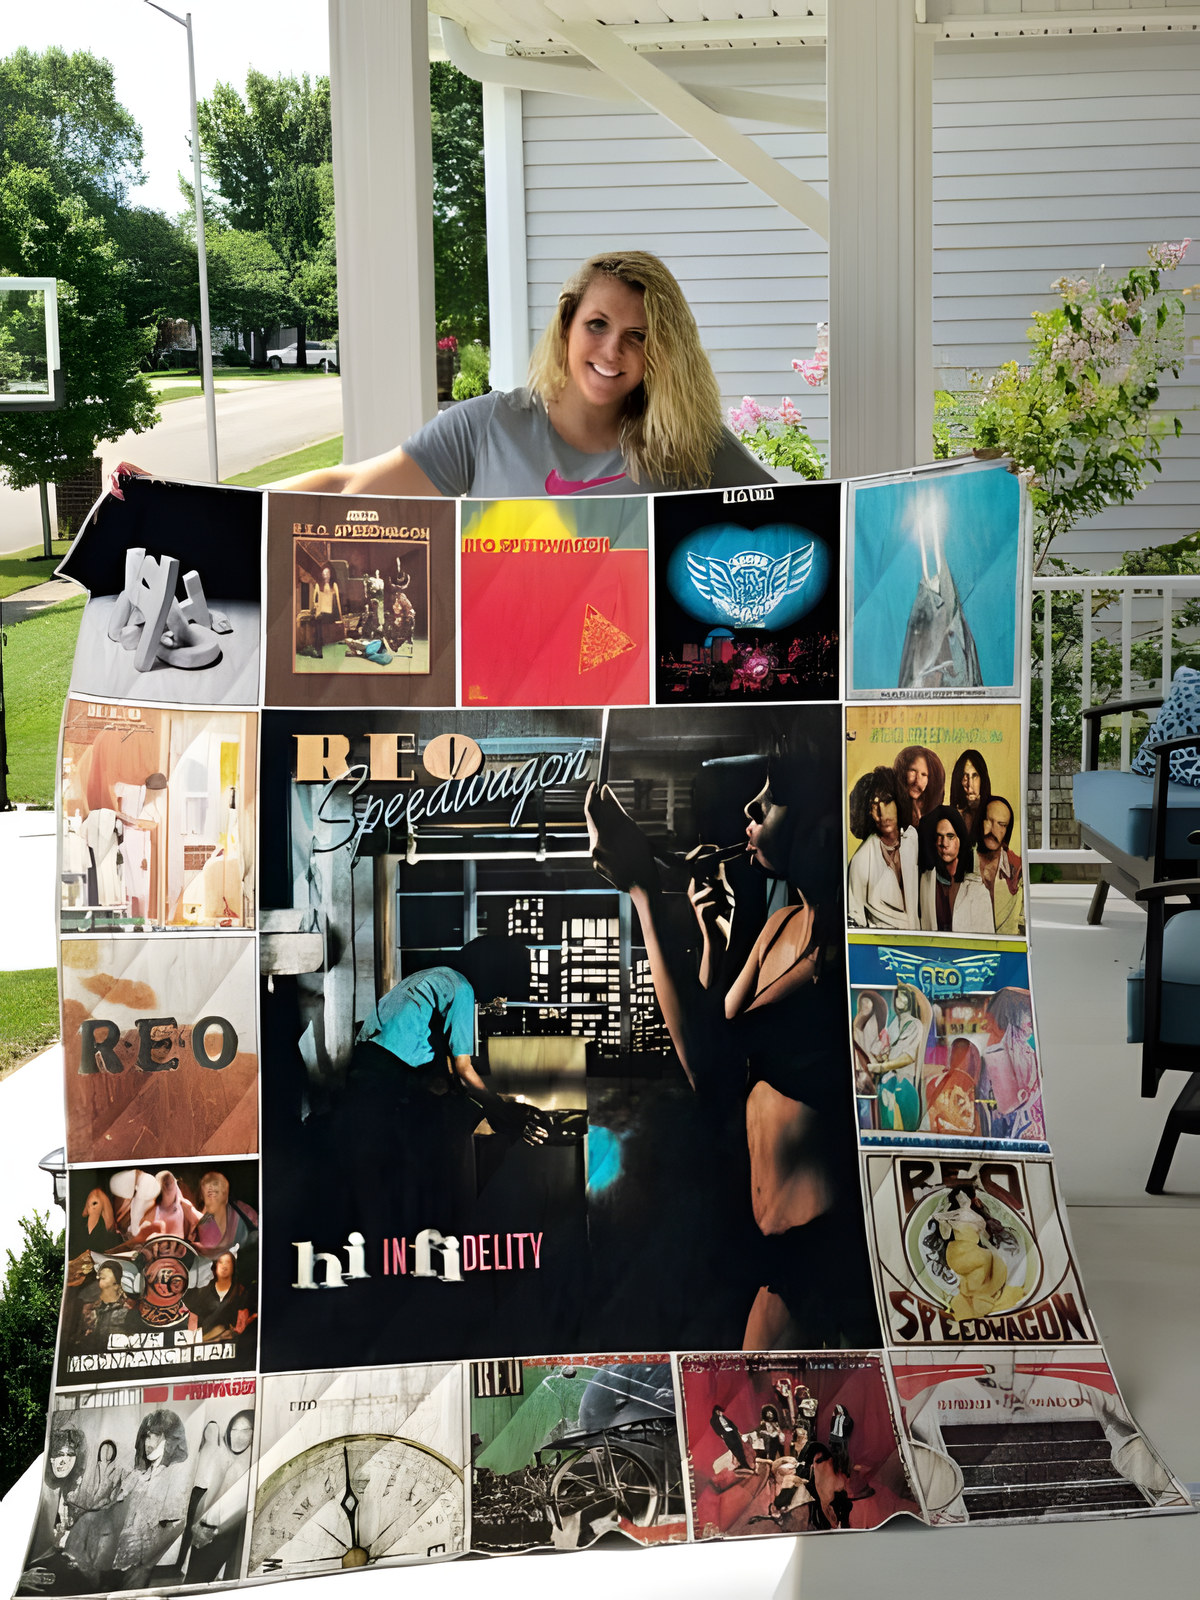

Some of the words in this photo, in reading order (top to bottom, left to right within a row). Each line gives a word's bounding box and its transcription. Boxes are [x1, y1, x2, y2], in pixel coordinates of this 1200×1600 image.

[292, 733, 483, 782] REO
[312, 749, 592, 866] Speedwagon
[900, 1160, 1025, 1216] REO
[292, 1231, 371, 1290] hi
[889, 1290, 1089, 1341] SPEEDWAGON
